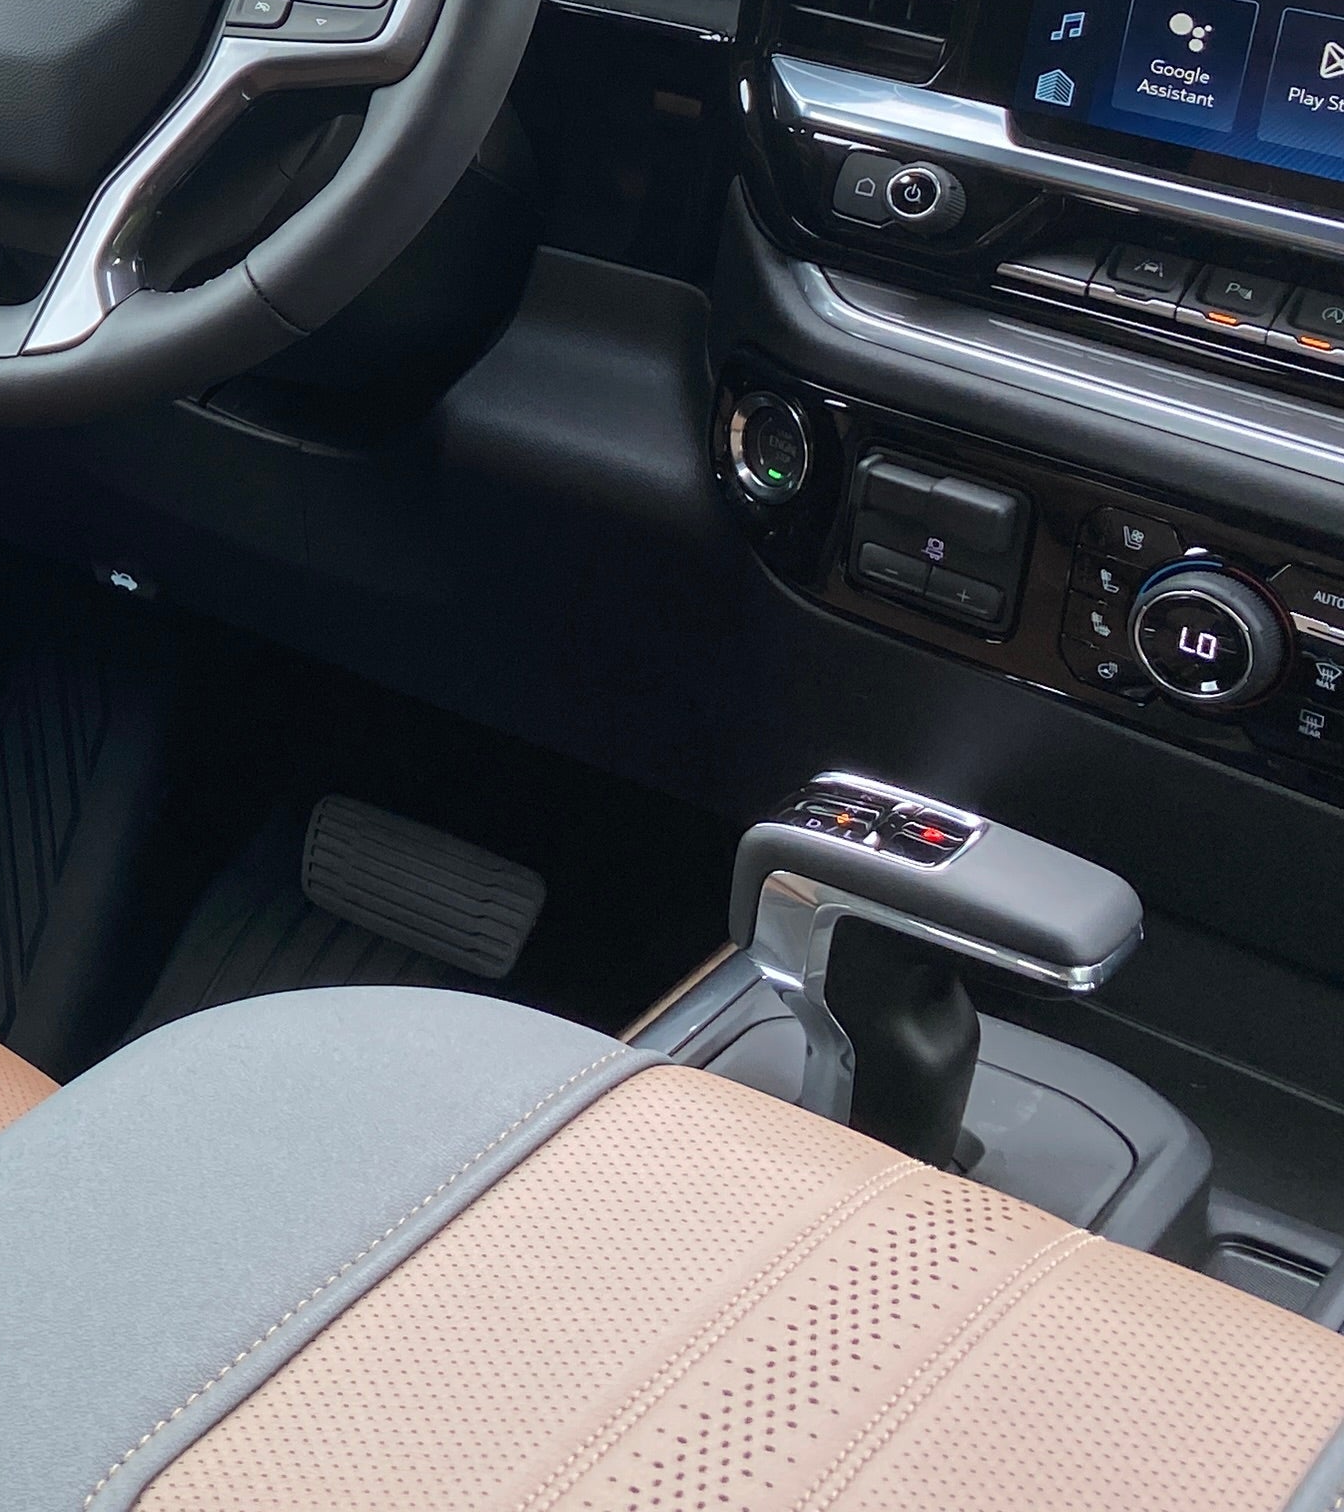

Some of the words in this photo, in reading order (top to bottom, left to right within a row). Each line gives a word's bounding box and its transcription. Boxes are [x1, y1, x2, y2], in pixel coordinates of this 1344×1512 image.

[1149, 58, 1211, 85] Google
[1136, 78, 1215, 109] Assistant
[1287, 86, 1324, 112] Play
[1313, 590, 1344, 609] AUTO
